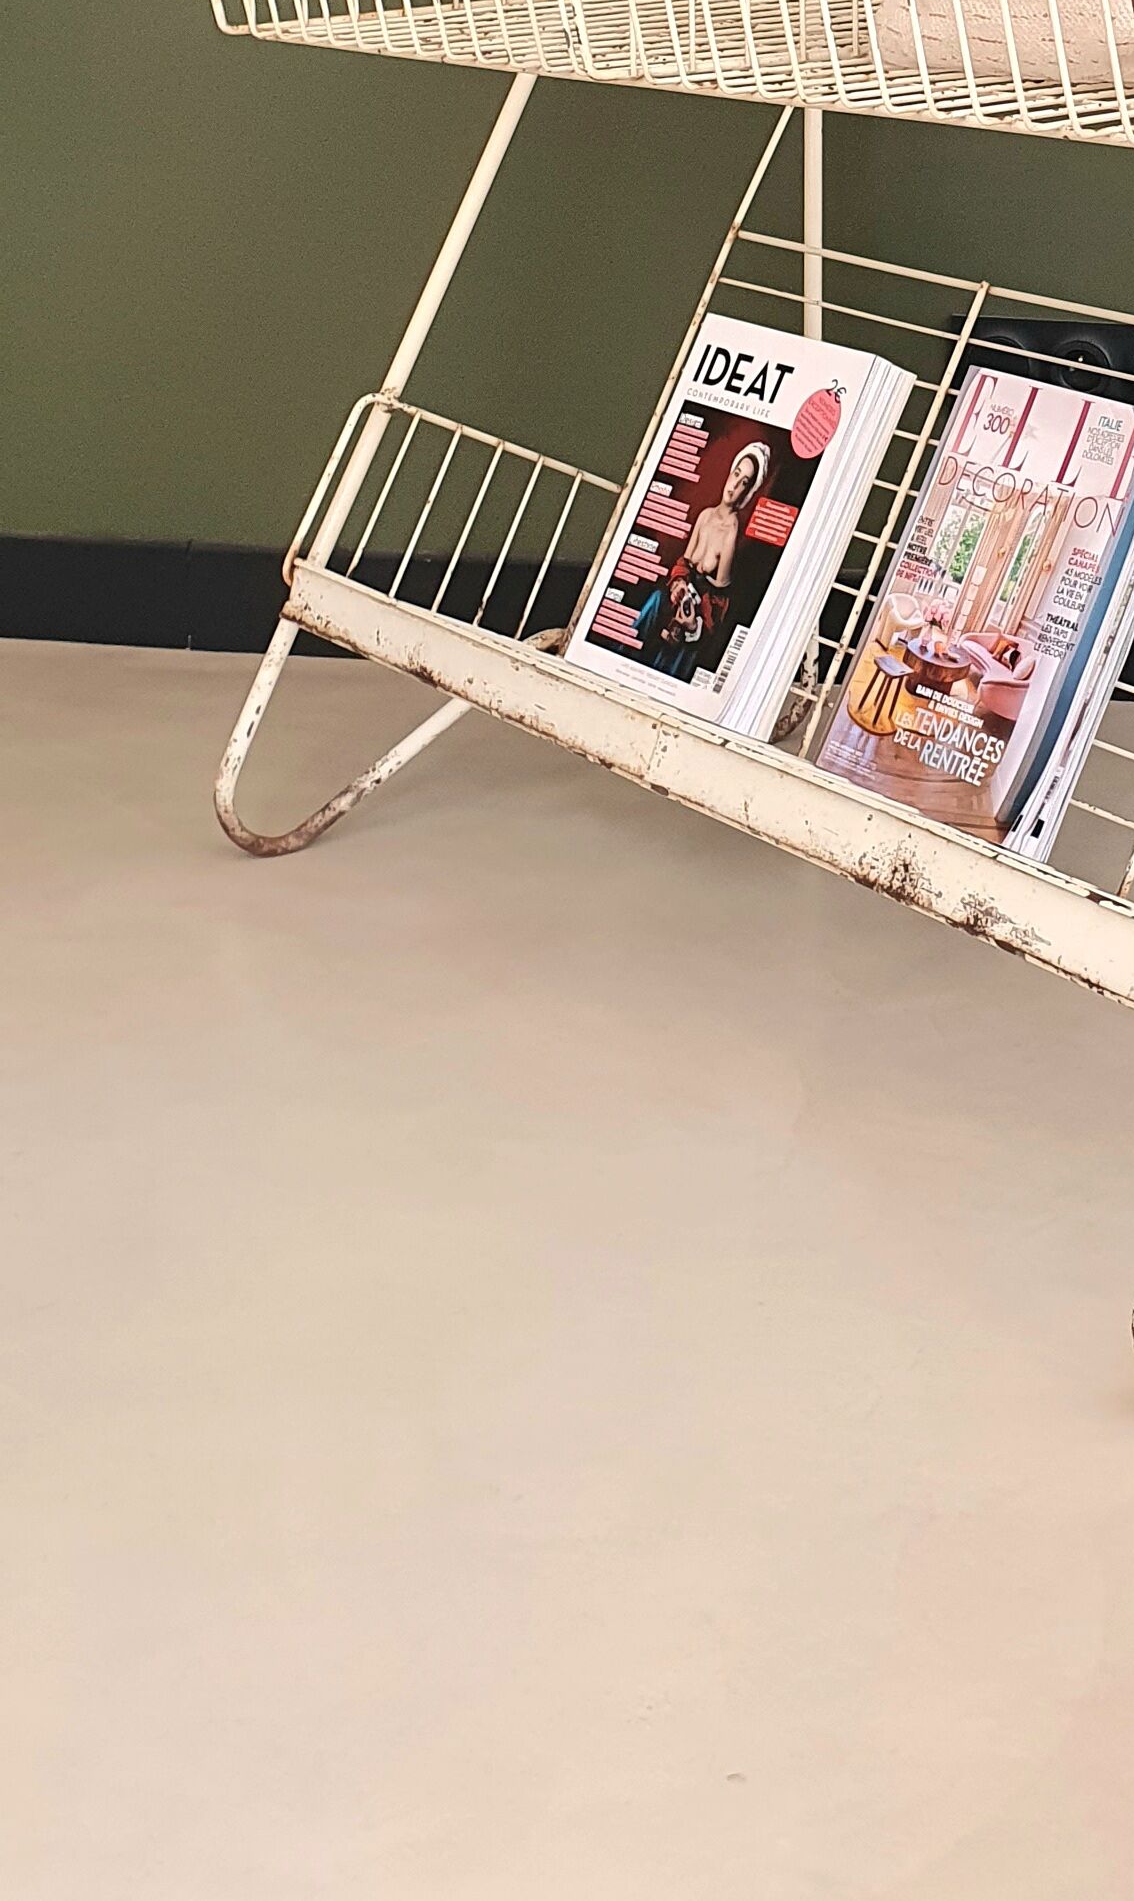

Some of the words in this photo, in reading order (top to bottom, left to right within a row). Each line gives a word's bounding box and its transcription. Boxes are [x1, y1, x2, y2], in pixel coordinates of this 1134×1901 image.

[692, 343, 796, 405] IDEAT
[686, 387, 751, 412] CONTEMPORARY
[752, 404, 772, 419] LIFE
[983, 413, 1011, 435] 300
[1098, 415, 1124, 432] ITALIE
[907, 542, 928, 555] NOTRE
[900, 560, 938, 578] COLLECTION
[1060, 576, 1078, 589] POUR
[1053, 595, 1086, 613] COULEURS
[915, 684, 933, 698] BAIN
[958, 711, 985, 729] DESIGN
[914, 706, 1006, 764] TENDANCES
[893, 728, 908, 746] DE
[907, 733, 921, 752] LA
[919, 739, 990, 788] RENTRÉE
